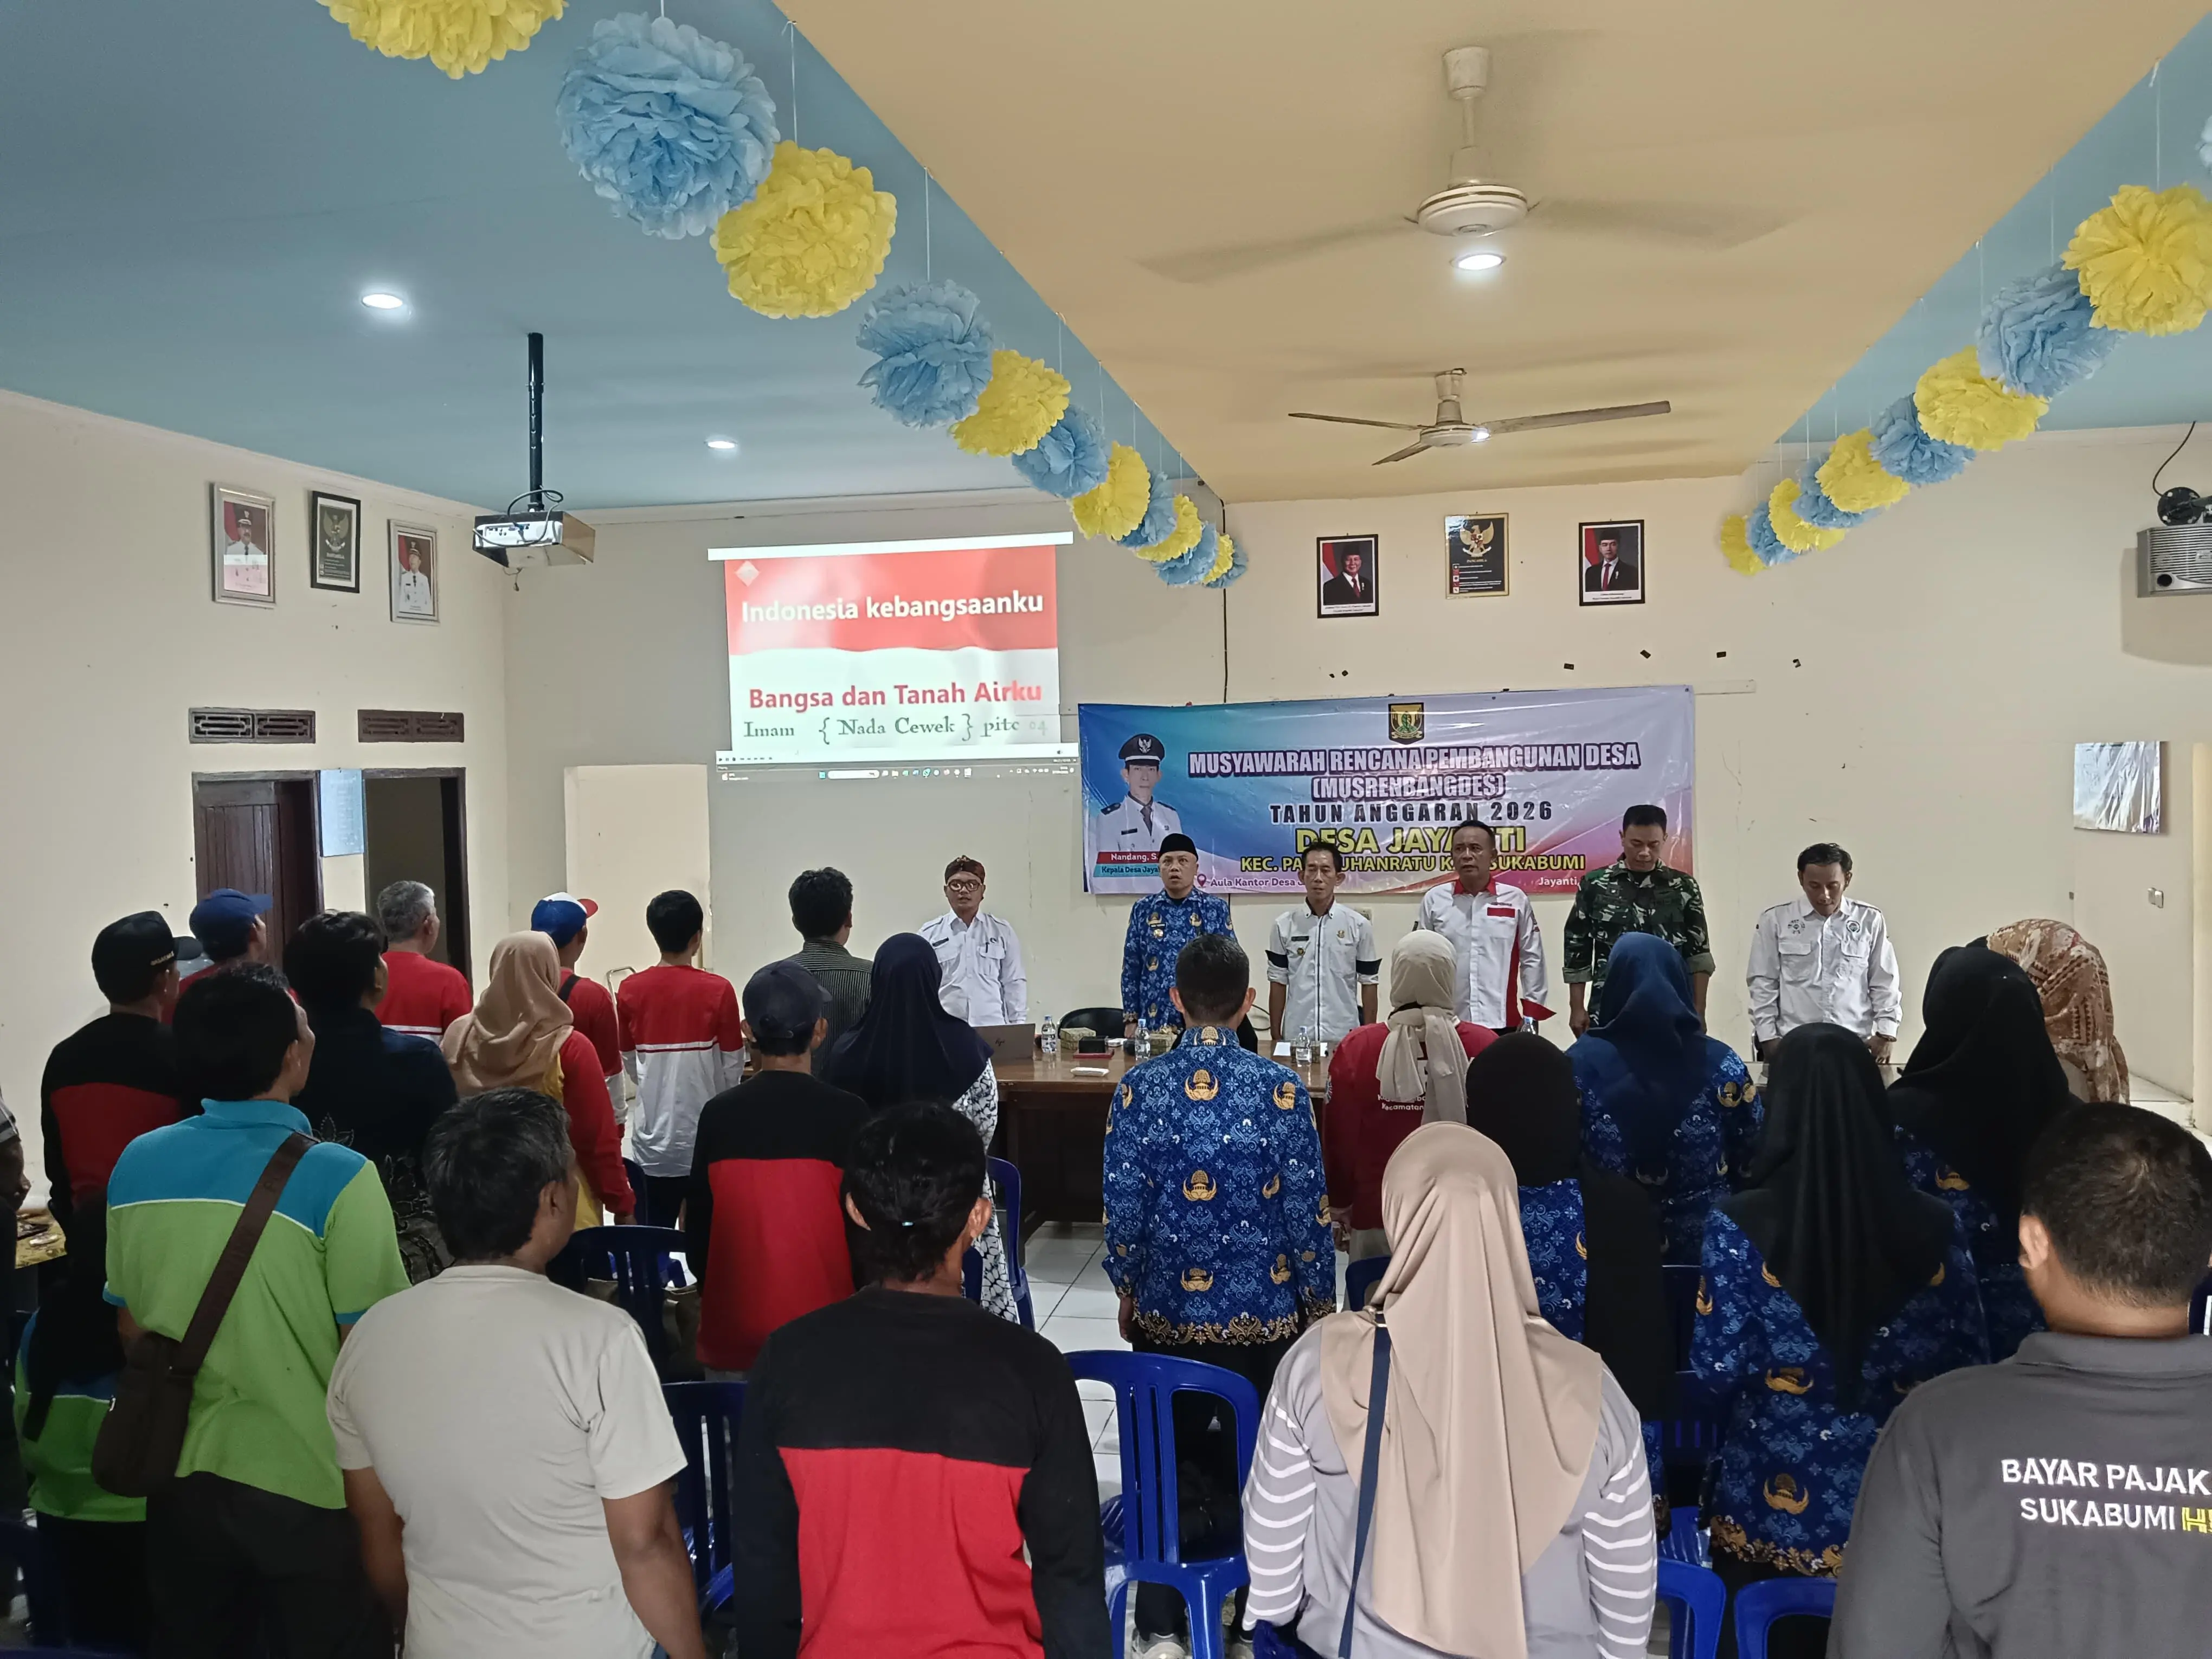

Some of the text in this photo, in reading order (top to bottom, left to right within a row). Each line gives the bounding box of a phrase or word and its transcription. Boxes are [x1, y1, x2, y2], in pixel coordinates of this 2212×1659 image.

[742, 590, 1043, 623] Indonesia kebangsaanku
[749, 680, 1042, 713] Bangsa dan Tanah Airku
[743, 722, 795, 737] Imam
[837, 717, 886, 735] Nada
[895, 716, 955, 734] Cewek
[1189, 743, 1640, 775] MUSYAWARAH RENCANA PEMBANGUNAN DESA
[1313, 774, 1506, 799] (MUSRENBANGDES)
[1270, 801, 1552, 824] TAHUN ANGGARAN 2026
[1390, 826, 1526, 853] JAYTI
[1102, 866, 1124, 874] Kepala
[1111, 853, 1149, 862] Nandang,
[1241, 857, 1278, 871] KEC.
[1283, 856, 1435, 871] PAUHANRATU
[1210, 878, 1233, 886] Aula
[1235, 878, 1269, 887] Kantor
[2001, 1457, 2211, 1496] BAYAR PAJAK
[2020, 1497, 2176, 1531] SUKABUMI
